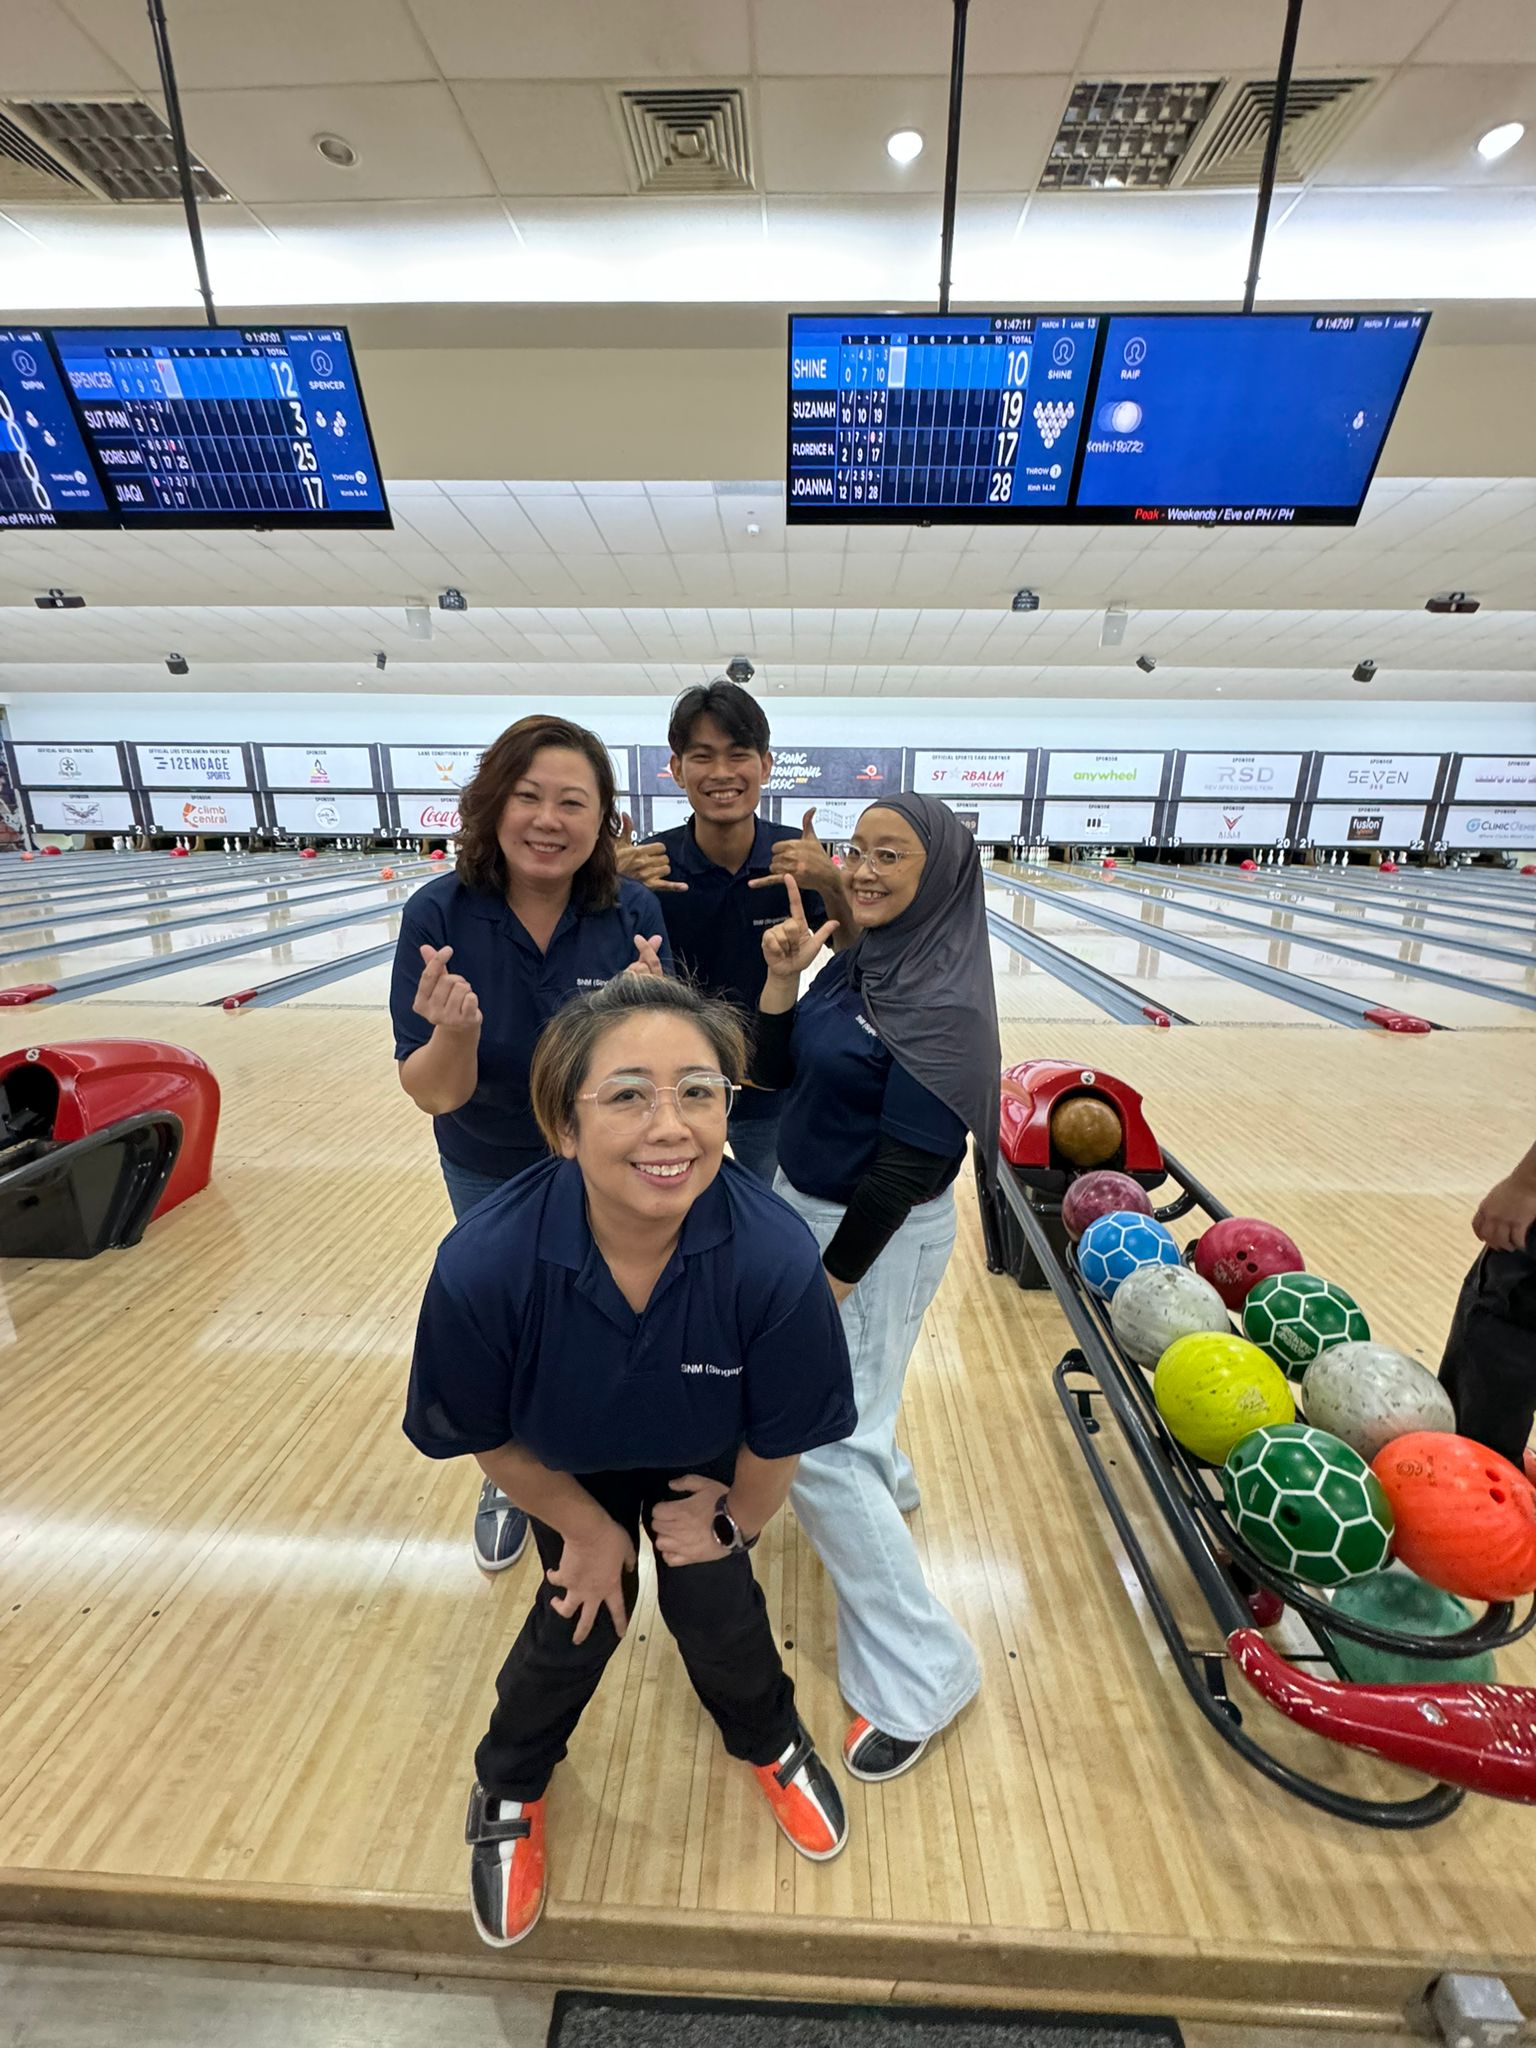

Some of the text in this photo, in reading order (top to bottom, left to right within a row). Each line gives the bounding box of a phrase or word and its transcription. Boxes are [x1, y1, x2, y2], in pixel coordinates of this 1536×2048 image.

[1003, 318, 1031, 330] 1:47:11
[1087, 318, 1096, 328] 13
[1325, 318, 1354, 330] 1:47:01
[1411, 316, 1422, 328] 14
[332, 331, 342, 341] 12
[864, 336, 868, 344] 2
[880, 336, 886, 344] 3
[995, 336, 1003, 344] 10
[794, 358, 828, 380] SHINE
[1008, 350, 1029, 386] 10
[1120, 369, 1141, 380] RAIF
[68, 372, 116, 388] SPENCER
[270, 360, 298, 398] 12
[845, 368, 885, 382] 0 7 10
[1048, 370, 1072, 380] SHINE
[308, 380, 346, 390] SPENCER
[793, 401, 836, 418] SUZANAH
[842, 408, 882, 424] 10 10 19
[1002, 391, 1023, 428] 19
[84, 410, 130, 429] SUT PAN
[135, 418, 160, 432] 3 3
[289, 401, 308, 437] 3
[7, 421, 27, 451] 0
[792, 443, 826, 456] FLORENCE
[842, 448, 880, 462] 2 9 17
[998, 432, 1018, 467] 17
[99, 450, 144, 464] DORIS LIM
[176, 456, 189, 470] 25
[293, 442, 318, 472] 25
[20, 450, 40, 482] 0
[302, 477, 323, 509] 17
[792, 478, 833, 496] JOANNA
[840, 486, 878, 500] 12 19 28
[990, 472, 1012, 502] 28
[32, 481, 52, 511] 0
[18, 512, 36, 524] PH
[40, 512, 56, 525] PH
[1134, 508, 1159, 520] Peak
[1167, 508, 1216, 520] Weekends
[1217, 508, 1224, 520] /
[1224, 508, 1242, 520] Eve
[1244, 508, 1254, 520] of
[1254, 508, 1272, 520] PH
[1278, 508, 1295, 520] PH
[170, 757, 230, 770] 12ENGAGE
[776, 752, 808, 765] SONIC
[206, 772, 231, 780] SPORTS
[1072, 768, 1138, 781] anywheel
[1217, 766, 1275, 783] RSD
[1348, 770, 1409, 784] SEVEN
[198, 806, 226, 815] climb
[192, 815, 228, 824] central
[1352, 817, 1380, 830] fusion
[30, 824, 36, 833] 1
[135, 826, 143, 834] 2
[150, 826, 157, 834] 3
[256, 828, 264, 836] 4
[272, 828, 280, 836] 5
[380, 829, 388, 838] 6
[394, 828, 402, 837] 7
[1012, 836, 1026, 846] 16
[1036, 835, 1048, 846] 17
[1144, 836, 1157, 846] 18
[1168, 836, 1180, 847] 19
[1276, 838, 1290, 848] 20
[1300, 838, 1312, 848] 21
[1410, 840, 1425, 850] 22
[1434, 842, 1448, 852] 23
[576, 978, 592, 986] SNM
[680, 1363, 703, 1374] SNM
